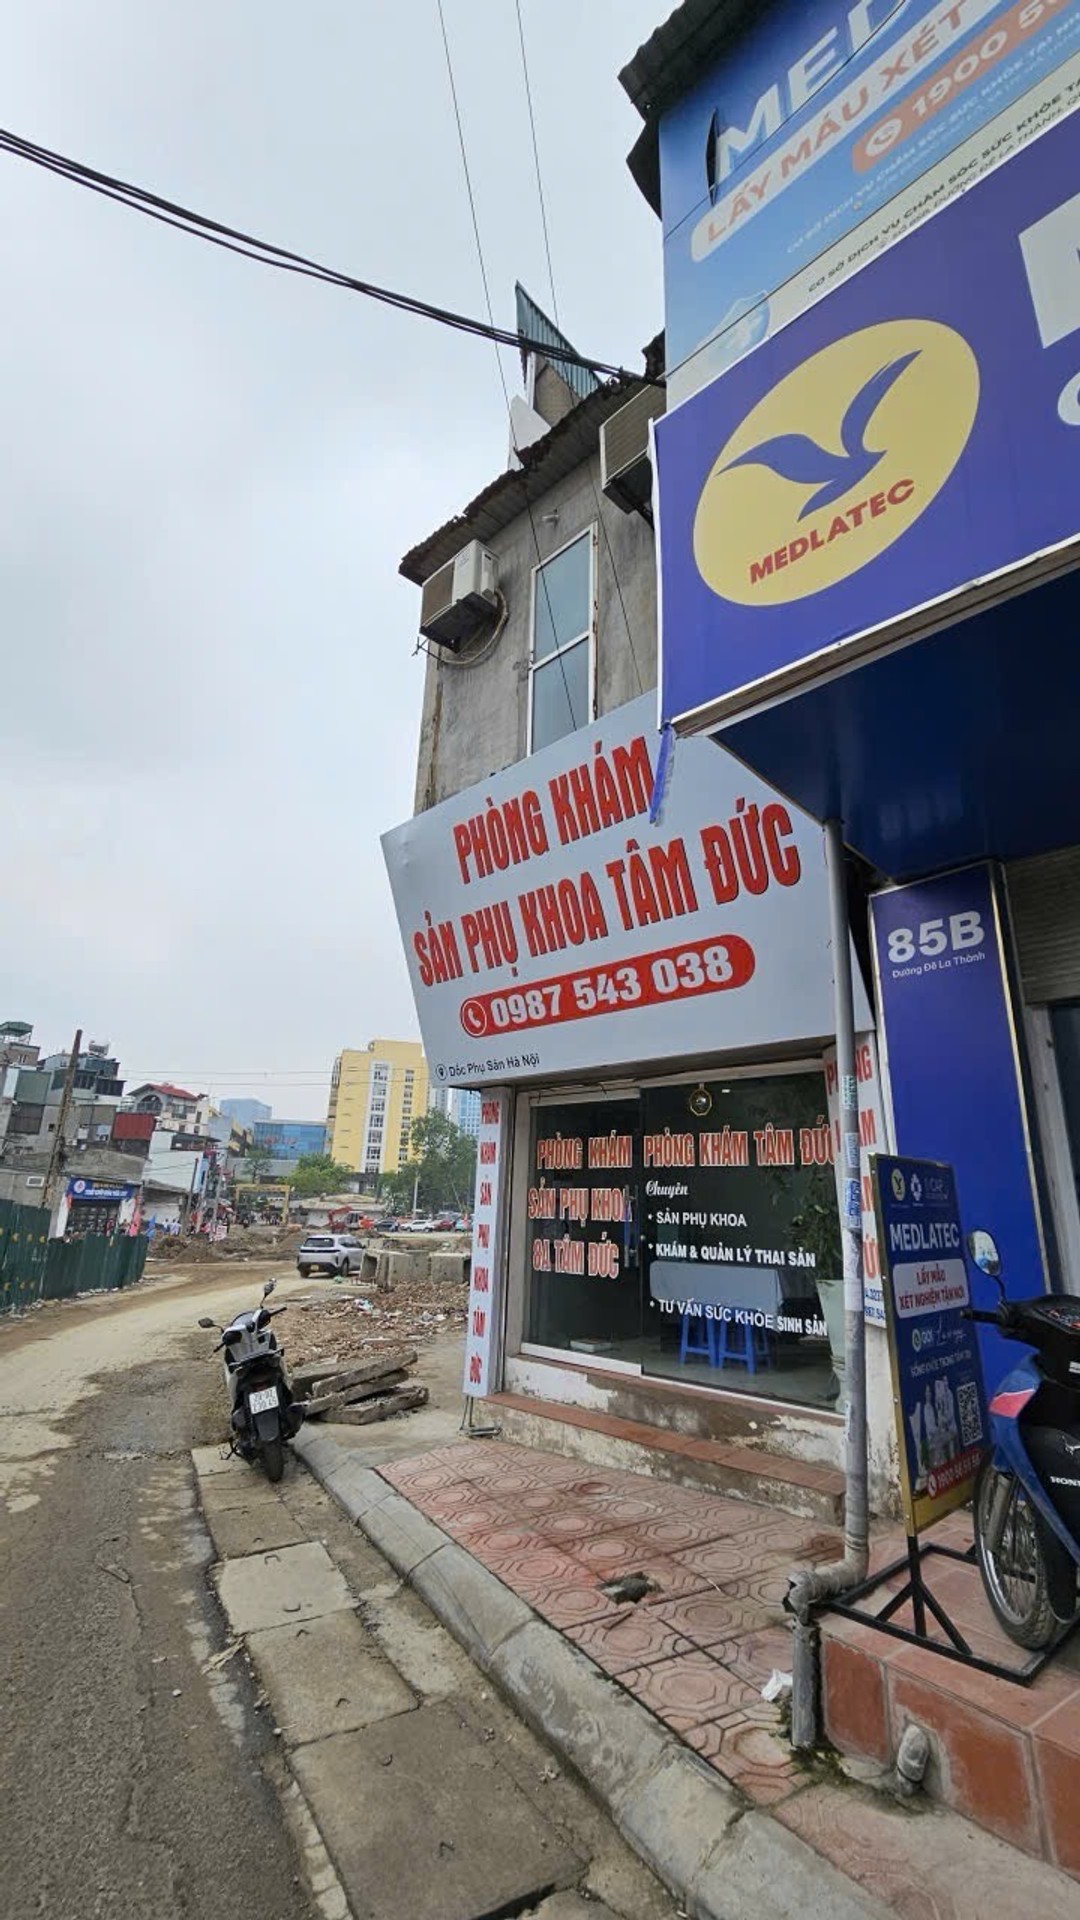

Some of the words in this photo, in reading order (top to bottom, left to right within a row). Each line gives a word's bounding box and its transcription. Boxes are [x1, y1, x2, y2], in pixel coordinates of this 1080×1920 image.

[911, 30, 1008, 118] 1900
[1018, 0, 1059, 29] 5
[708, 170, 772, 242] LẤY
[879, 0, 967, 92] XÉT
[750, 478, 915, 585] MEDLATEC
[453, 796, 550, 885] PHÒNG
[548, 736, 656, 846] KHÁM
[414, 910, 465, 987] SẢN
[461, 901, 520, 978] PHỤ
[518, 871, 609, 958] KHOA
[605, 838, 699, 931] TÂM
[700, 797, 801, 906] ĐỨC
[888, 911, 985, 963] 85B
[490, 984, 561, 1028] 0987
[573, 967, 642, 1011] 543
[651, 945, 734, 995] 038
[892, 966, 922, 979] Đường
[924, 960, 937, 972] Đê
[939, 960, 951, 969] La
[953, 951, 985, 966] Thành
[521, 1053, 540, 1068] Nội
[826, 1044, 873, 1097] PNG
[643, 1126, 695, 1168] PHÒNG
[699, 1125, 749, 1167] KHÁM
[753, 1122, 795, 1166] TÂM
[527, 1176, 556, 1219] SẢN
[560, 1187, 589, 1228] PHỤ
[645, 1180, 690, 1199] Chuyên
[656, 1207, 680, 1226] SẢN
[682, 1211, 707, 1229] PHỤ
[710, 1213, 748, 1228] KHOA
[889, 1222, 960, 1252] MEDLATEC
[554, 1232, 584, 1275] TÂM
[588, 1231, 620, 1279] ĐỨC
[656, 1240, 687, 1259] KHÁM
[689, 1246, 698, 1260] &
[701, 1241, 734, 1262] QUẢN
[737, 1247, 751, 1264] LÝ
[755, 1249, 786, 1266] THAI
[788, 1246, 816, 1268] SẢN
[659, 1299, 675, 1314] TƯ
[677, 1297, 702, 1318] VẤN
[705, 1303, 732, 1321] SỨC
[735, 1308, 774, 1329] KHỎE
[777, 1316, 803, 1334] SINH
[805, 1313, 828, 1337] SẢN
